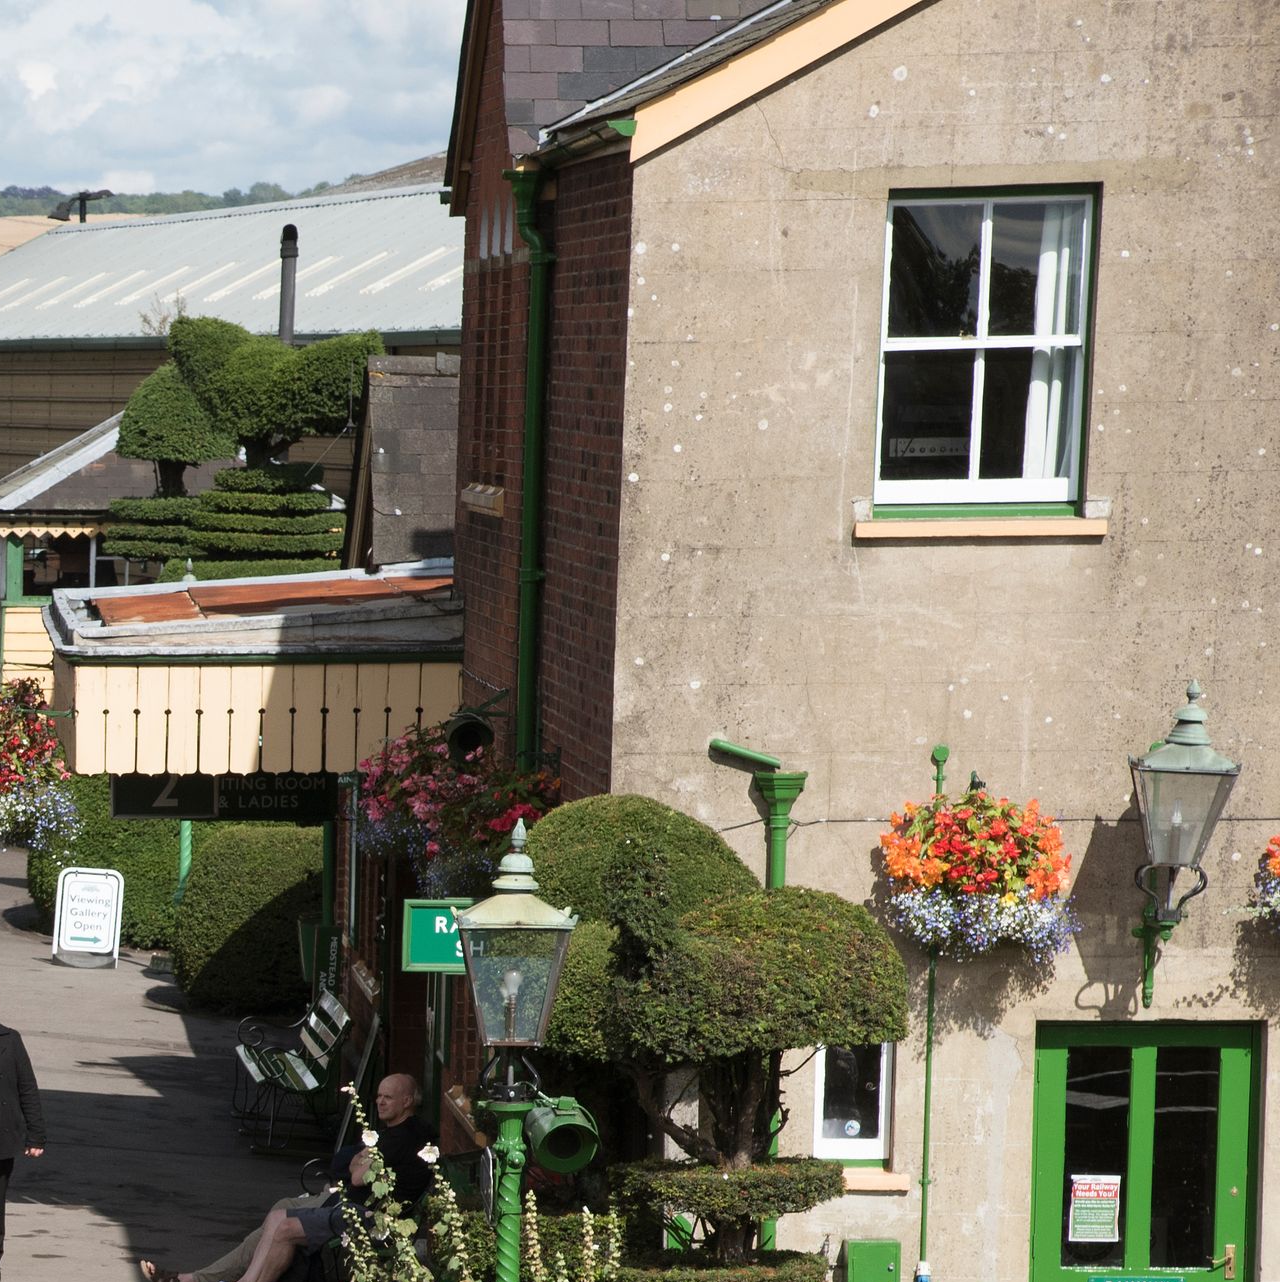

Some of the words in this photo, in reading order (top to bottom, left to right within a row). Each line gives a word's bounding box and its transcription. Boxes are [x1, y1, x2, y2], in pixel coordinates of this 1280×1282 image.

[220, 777, 268, 791] ITING
[274, 777, 326, 790] ROOM
[218, 795, 230, 809] &
[238, 795, 300, 809] LADIES
[70, 894, 111, 908] Viewing
[70, 907, 108, 920] Gallery
[73, 920, 103, 931] Open
[328, 936, 339, 987] MEDSTEAD
[1073, 1183, 1090, 1191] Your
[1091, 1183, 1119, 1191] Railway
